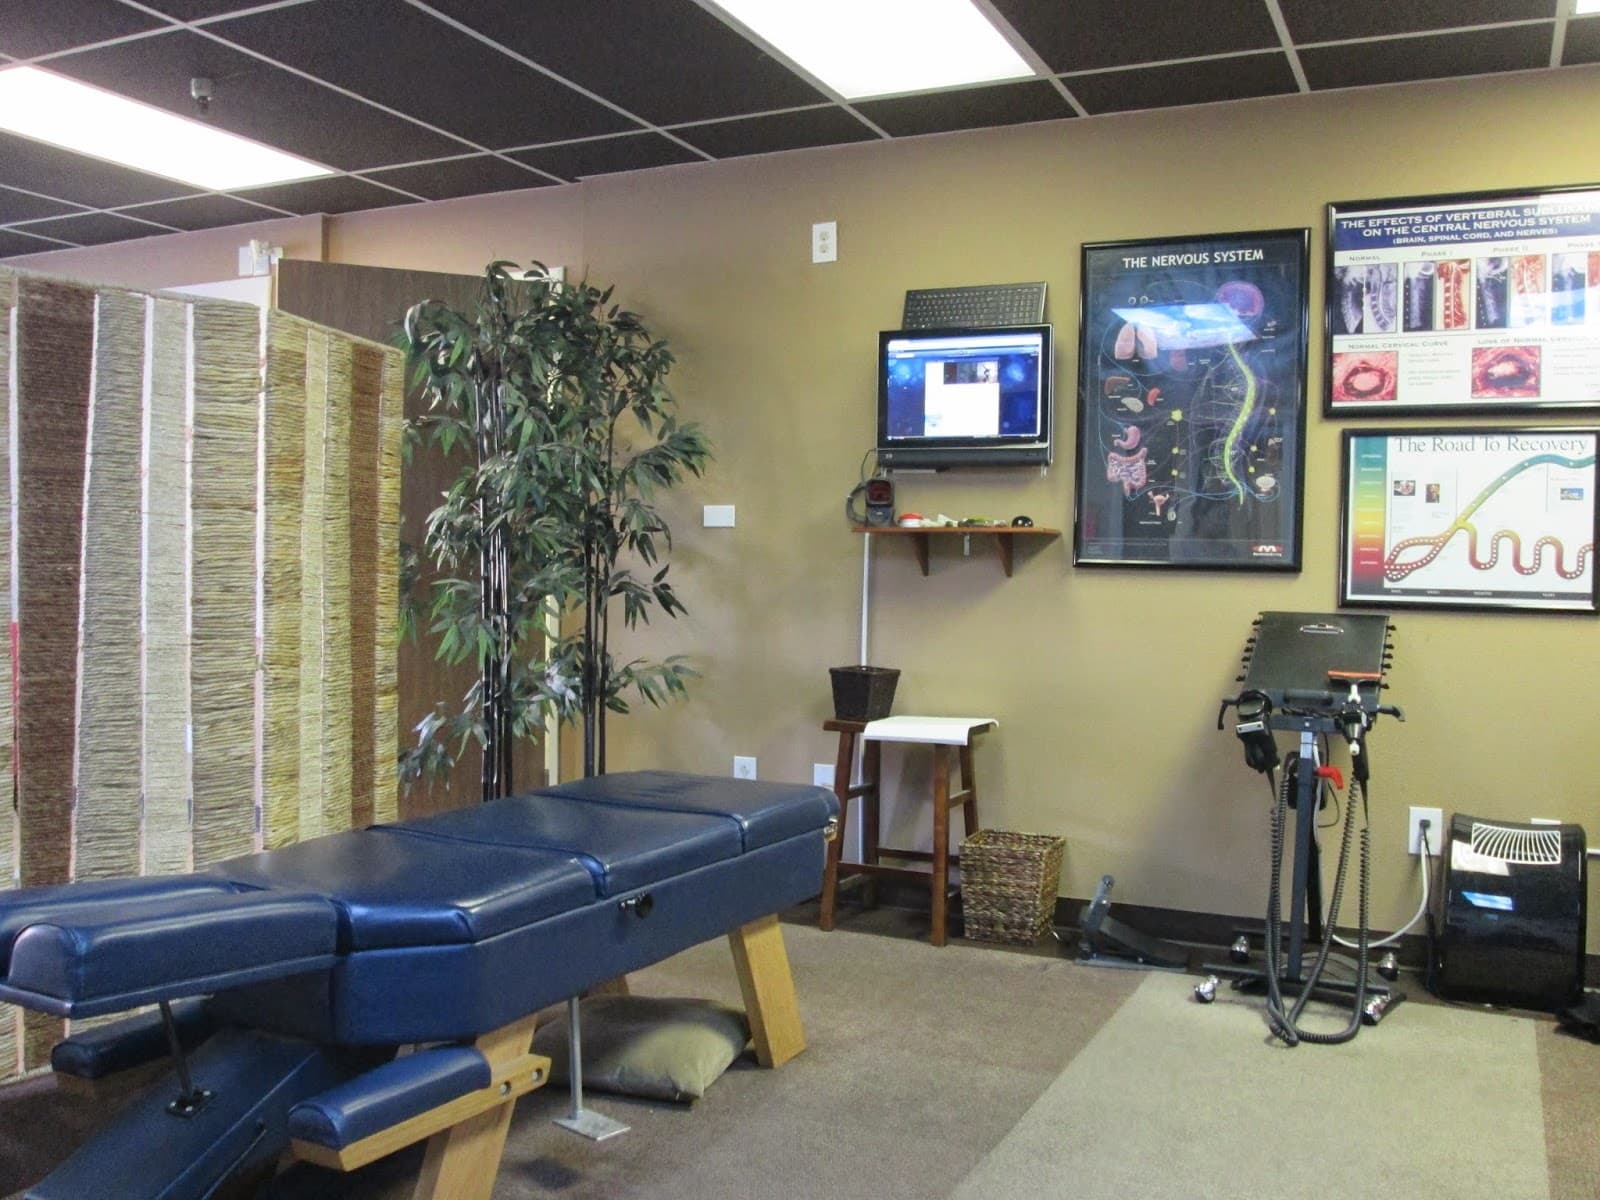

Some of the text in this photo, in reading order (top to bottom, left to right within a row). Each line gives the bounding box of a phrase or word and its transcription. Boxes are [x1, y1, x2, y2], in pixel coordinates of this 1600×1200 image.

[1342, 219, 1365, 229] THE
[1369, 216, 1422, 227] EFFECTS
[1425, 214, 1441, 223] OF
[1445, 209, 1520, 221] VERTEBRAL
[1362, 213, 1591, 237] ON THE CENTRAL NERVOUS SYSTEM
[1428, 234, 1461, 243] SPINAL
[1494, 230, 1515, 239] AND
[1122, 249, 1264, 269] THE NERVOUS SYSTEM
[1394, 435, 1588, 455] The Road To Recovery
